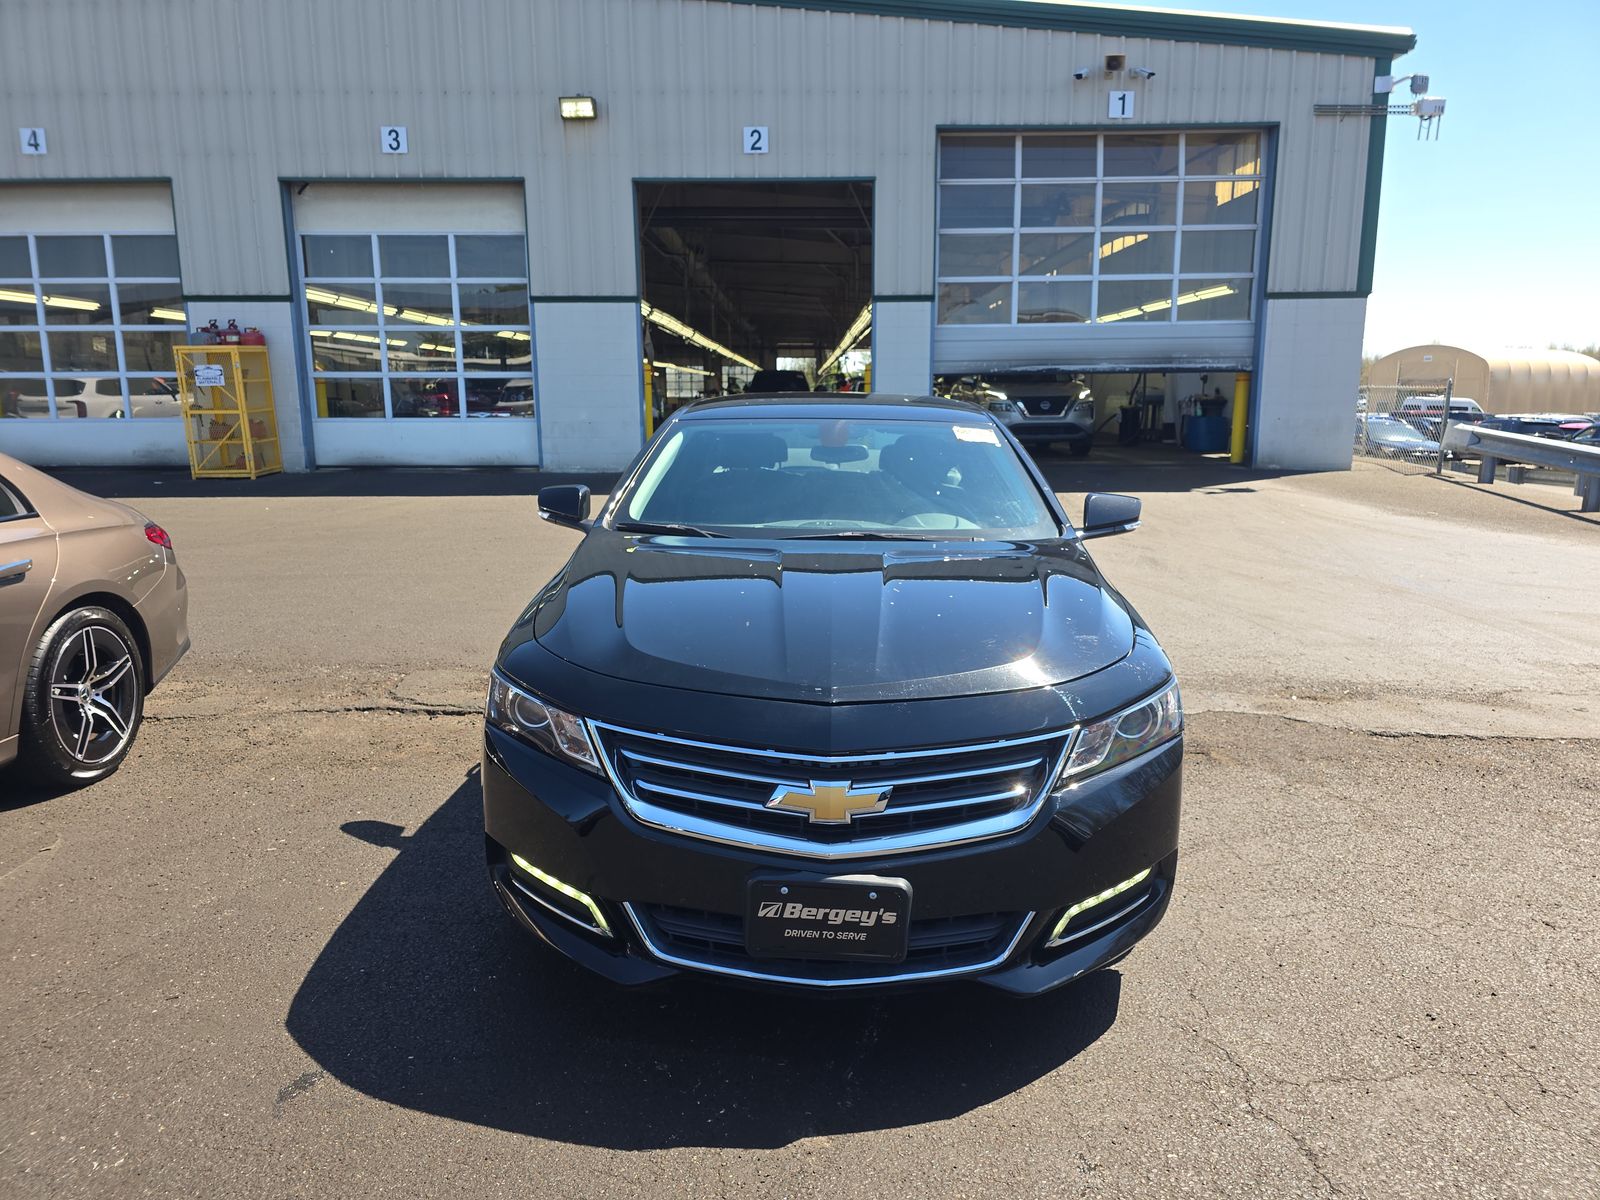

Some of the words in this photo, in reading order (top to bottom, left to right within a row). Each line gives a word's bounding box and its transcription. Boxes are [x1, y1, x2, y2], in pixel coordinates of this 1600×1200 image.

[1118, 93, 1126, 116] 1
[27, 129, 41, 152] 4
[388, 129, 401, 152] 3
[750, 129, 763, 151] 2
[783, 902, 897, 927] Bergey's
[784, 929, 820, 938] DRIVEN
[822, 930, 835, 939] TO
[836, 931, 867, 941] SERVE
